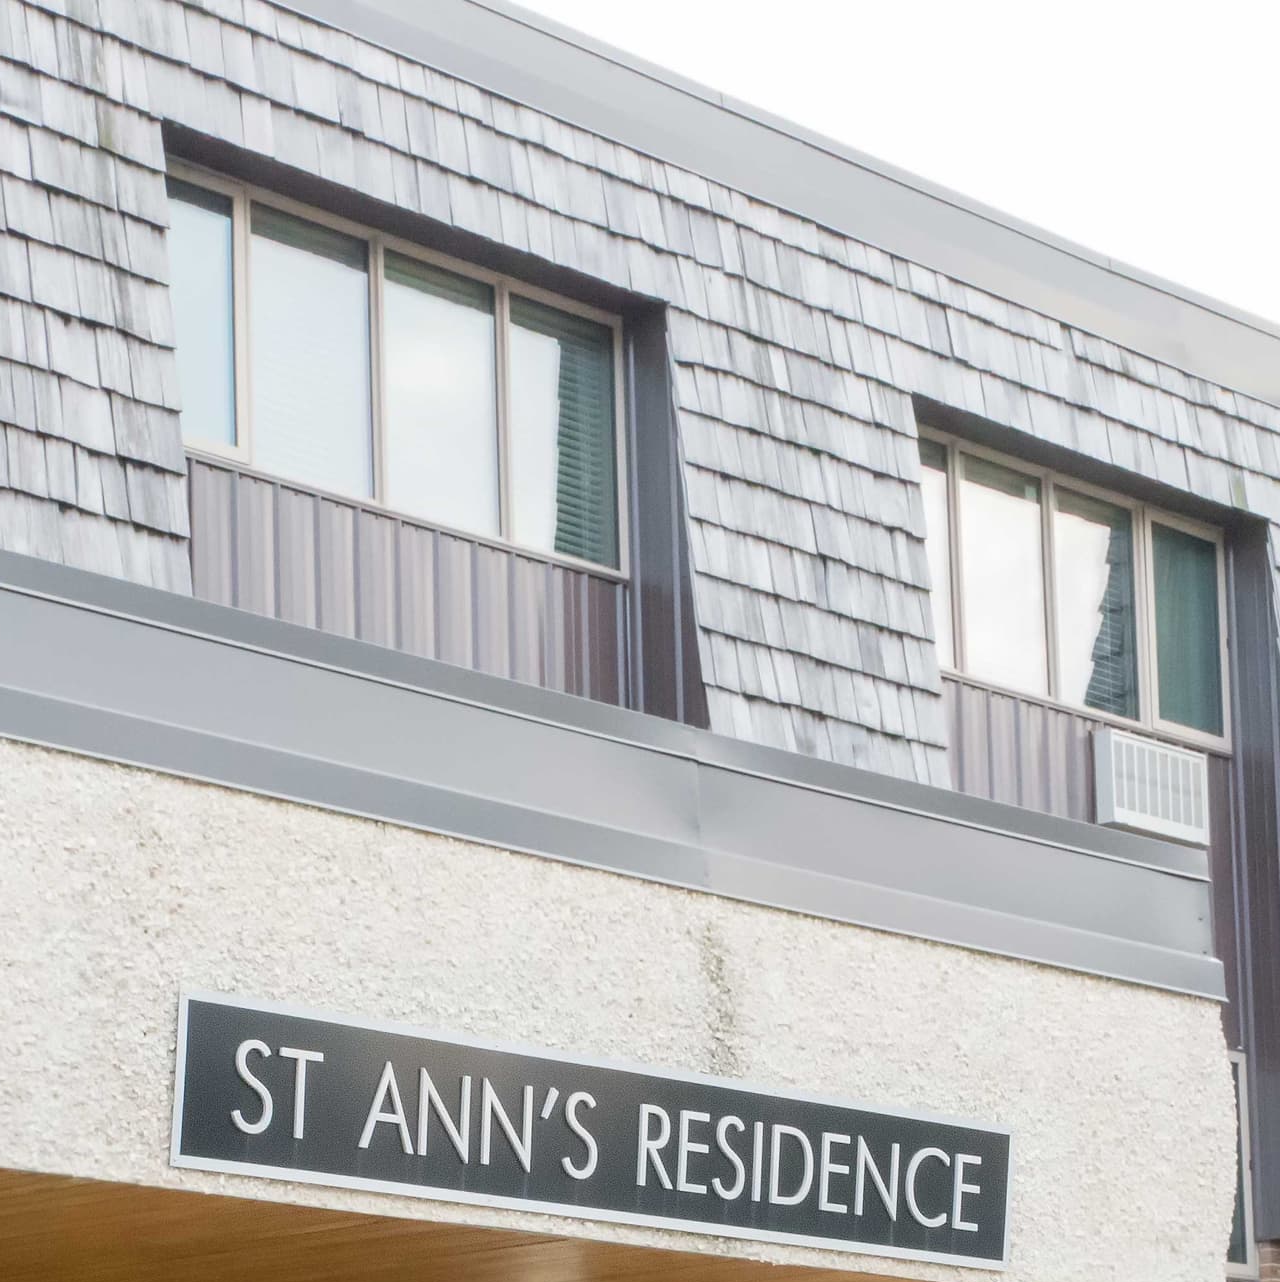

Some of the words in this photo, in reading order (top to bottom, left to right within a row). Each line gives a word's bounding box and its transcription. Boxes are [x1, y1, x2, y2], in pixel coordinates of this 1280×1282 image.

[230, 1038, 325, 1140] ST
[358, 1060, 599, 1181] ANN'S
[636, 1103, 982, 1232] RESIDENCE
